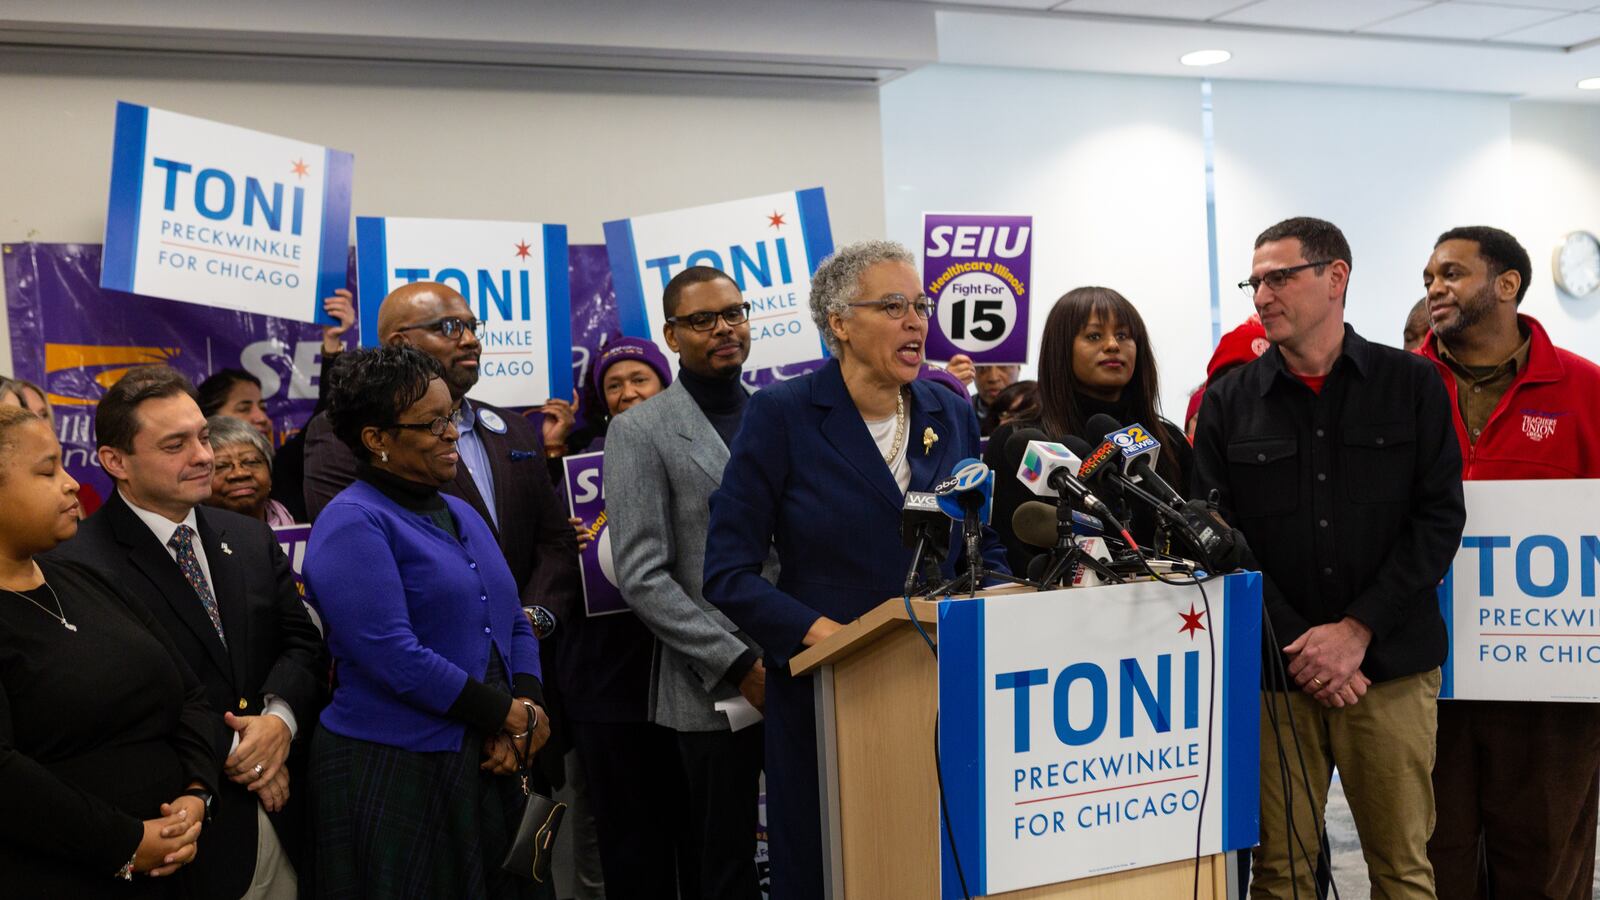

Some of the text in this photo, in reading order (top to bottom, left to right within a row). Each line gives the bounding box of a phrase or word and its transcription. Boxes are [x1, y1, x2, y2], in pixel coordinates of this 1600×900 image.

[153, 157, 305, 236] TONI
[161, 220, 301, 260] PRECKWINKLE
[926, 225, 1030, 258] SEIU
[158, 251, 300, 288] FOR CHICAGO
[929, 261, 1025, 296] Healthcare Illinois
[952, 283, 1005, 297] Fight For
[951, 299, 1006, 342] 15
[240, 340, 330, 400] SE
[1128, 427, 1149, 443] 2
[1522, 415, 1557, 426] TEACHERS
[1522, 422, 1556, 436] UNION
[1122, 438, 1154, 454] NEWS
[935, 478, 958, 491] abc
[956, 463, 988, 490] 7
[909, 494, 938, 504] WG
[1480, 608, 1600, 627] PRECKWI
[1480, 644, 1527, 663] FOR
[995, 650, 1199, 754] TONI
[1014, 743, 1199, 792] PRECKWINKLE
[1015, 789, 1200, 840] FOR CHICAGO
